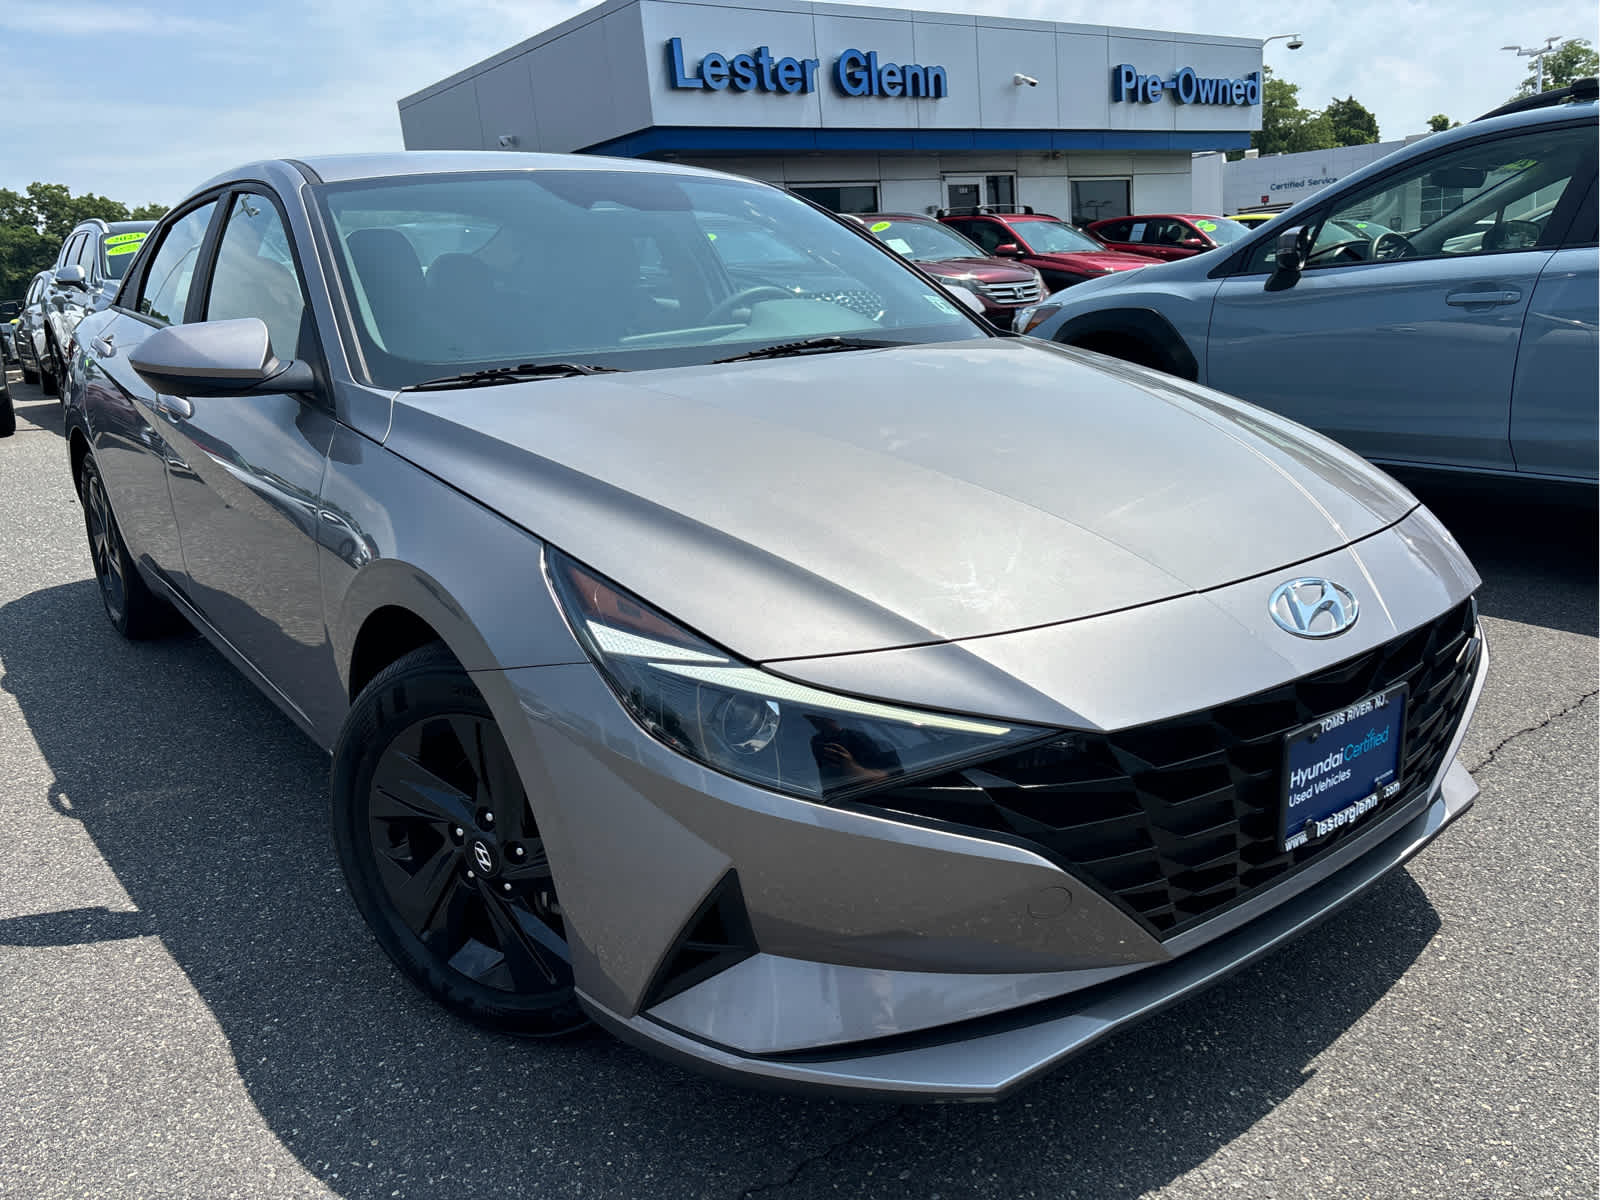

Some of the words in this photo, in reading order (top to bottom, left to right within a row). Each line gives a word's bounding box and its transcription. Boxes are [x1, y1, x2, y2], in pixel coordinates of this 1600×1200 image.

[666, 37, 819, 94] Lester
[834, 48, 948, 97] Glenn
[1113, 64, 1260, 104] Pre-Owned
[1270, 180, 1305, 191] Certified
[1307, 177, 1338, 186] Service
[1320, 712, 1346, 733] TOMS
[1290, 748, 1344, 789] Hyundai
[1344, 725, 1390, 761] Certified
[1289, 785, 1313, 807] Used
[1314, 768, 1352, 794] Vehicles
